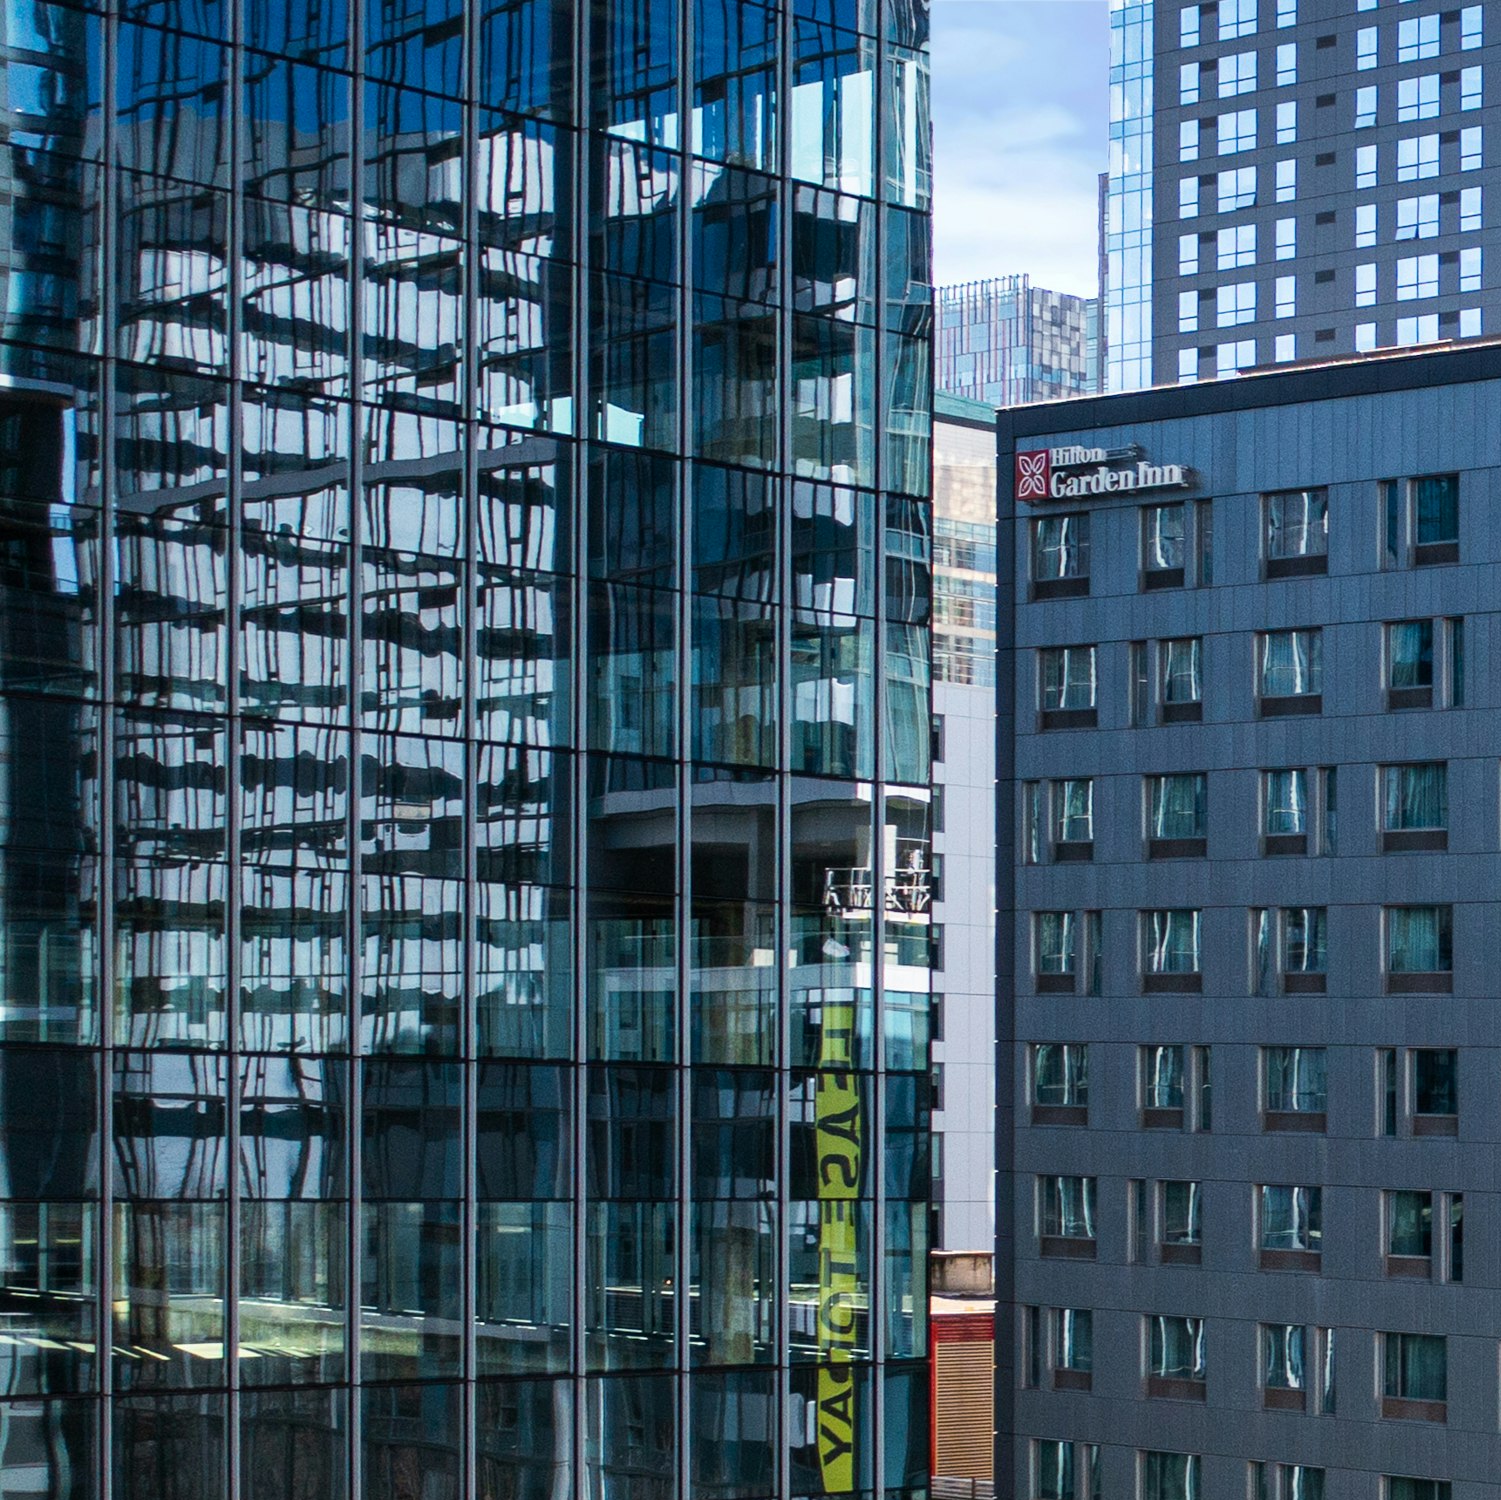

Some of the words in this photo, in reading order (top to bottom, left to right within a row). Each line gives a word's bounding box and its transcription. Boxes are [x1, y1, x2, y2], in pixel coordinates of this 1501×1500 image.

[1051, 446, 1104, 467] Hilton
[1050, 467, 1134, 498] Garden
[1137, 462, 1183, 488] Inn
